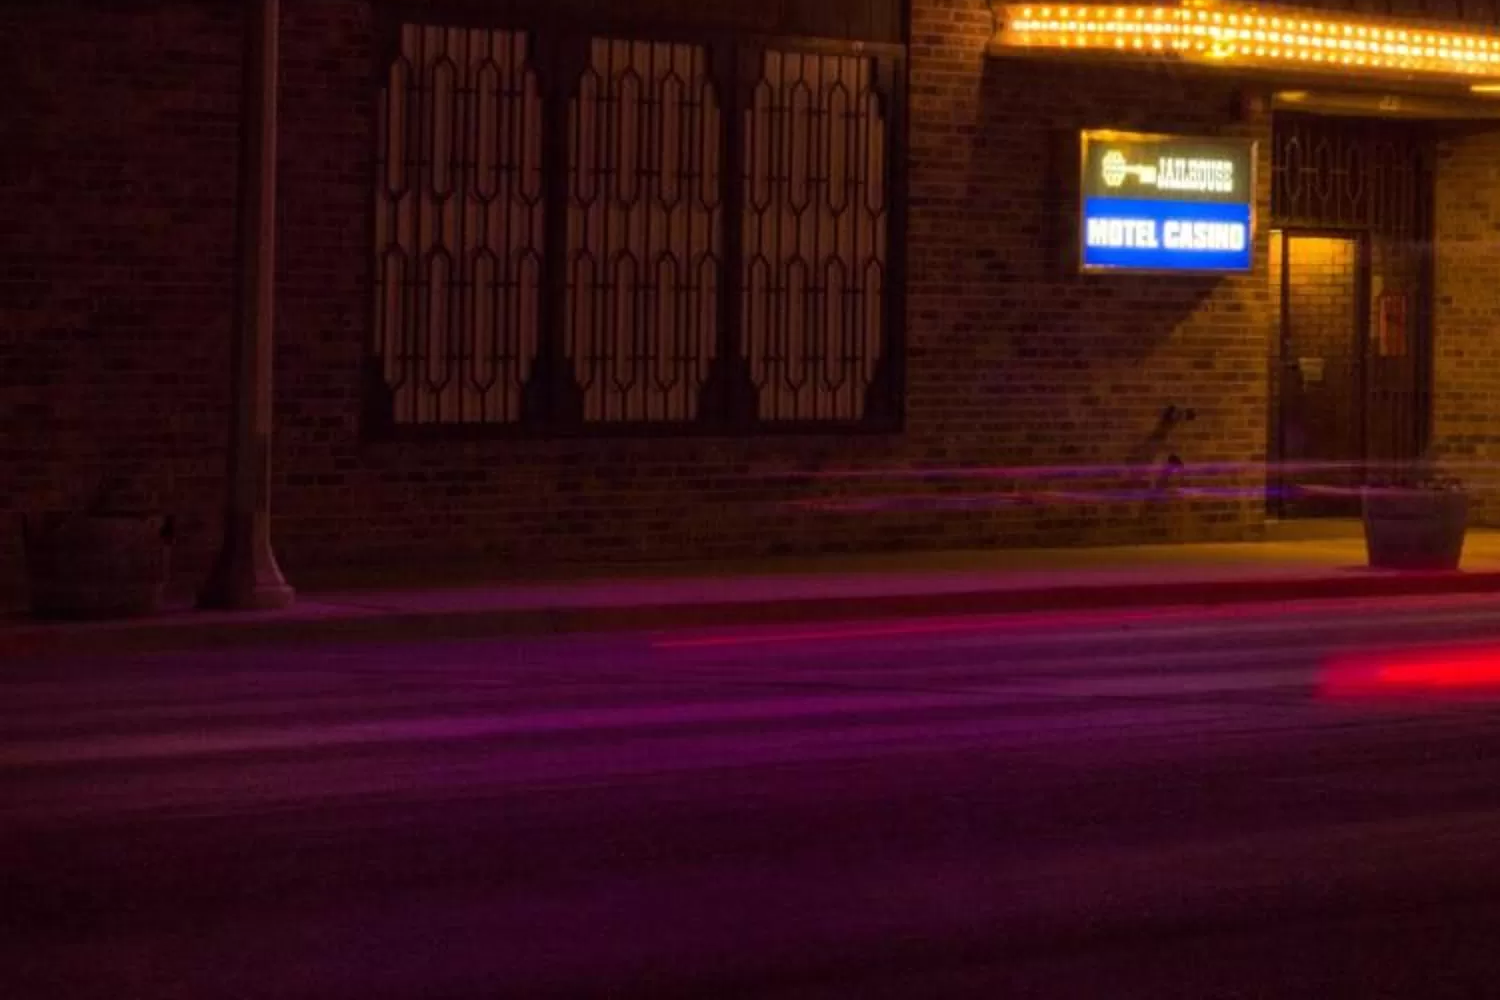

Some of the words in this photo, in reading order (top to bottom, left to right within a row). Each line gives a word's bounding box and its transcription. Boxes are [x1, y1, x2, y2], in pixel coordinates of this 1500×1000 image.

[1156, 156, 1234, 193] JAILHOUSE
[1086, 217, 1159, 249] MOTEL
[1162, 219, 1246, 252] CASINO
